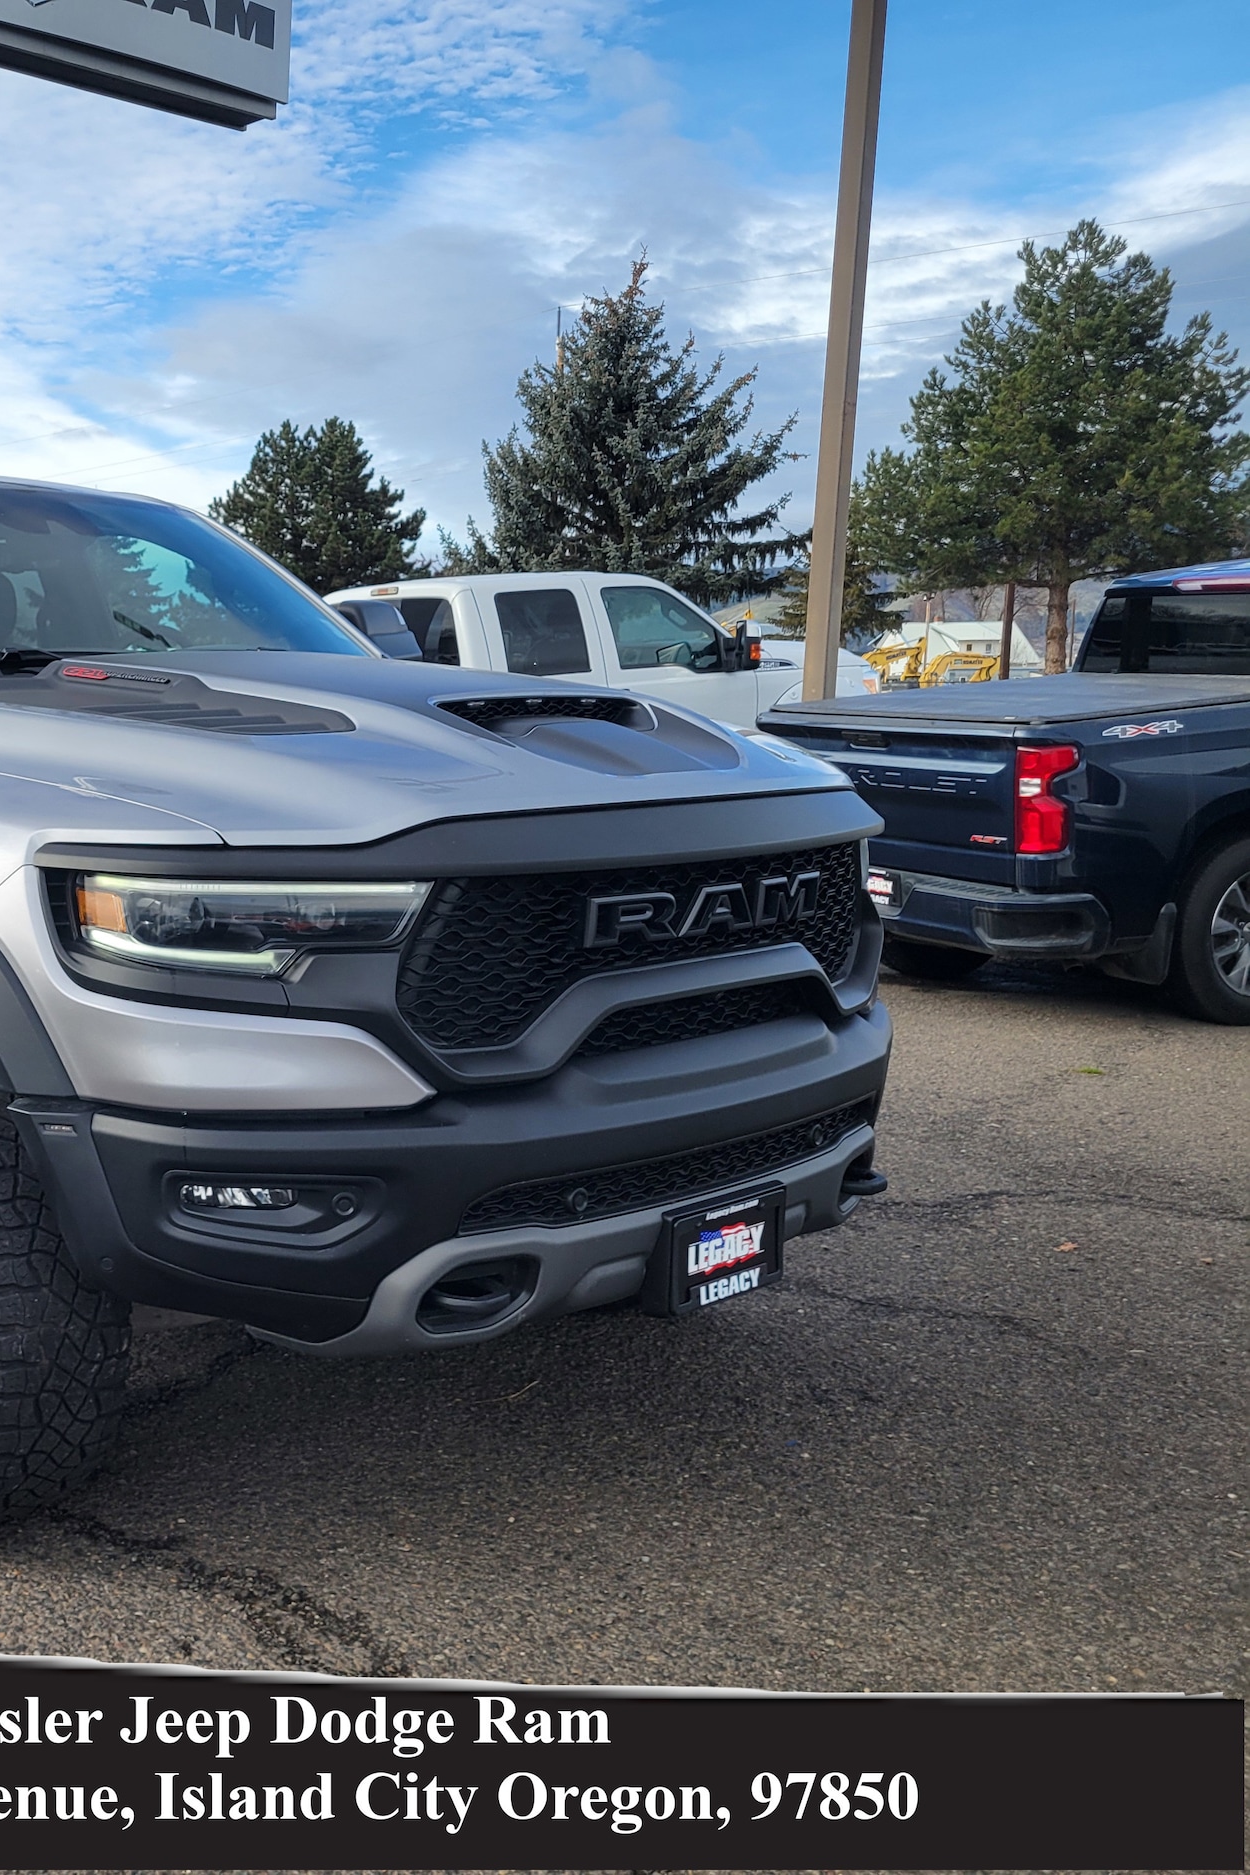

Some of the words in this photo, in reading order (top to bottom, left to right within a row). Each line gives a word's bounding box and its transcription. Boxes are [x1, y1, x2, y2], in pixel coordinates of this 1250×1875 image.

[970, 834, 1008, 844] RST
[582, 871, 820, 949] RAM
[687, 1222, 765, 1275] LEGACY
[700, 1267, 761, 1306] LEGACY
